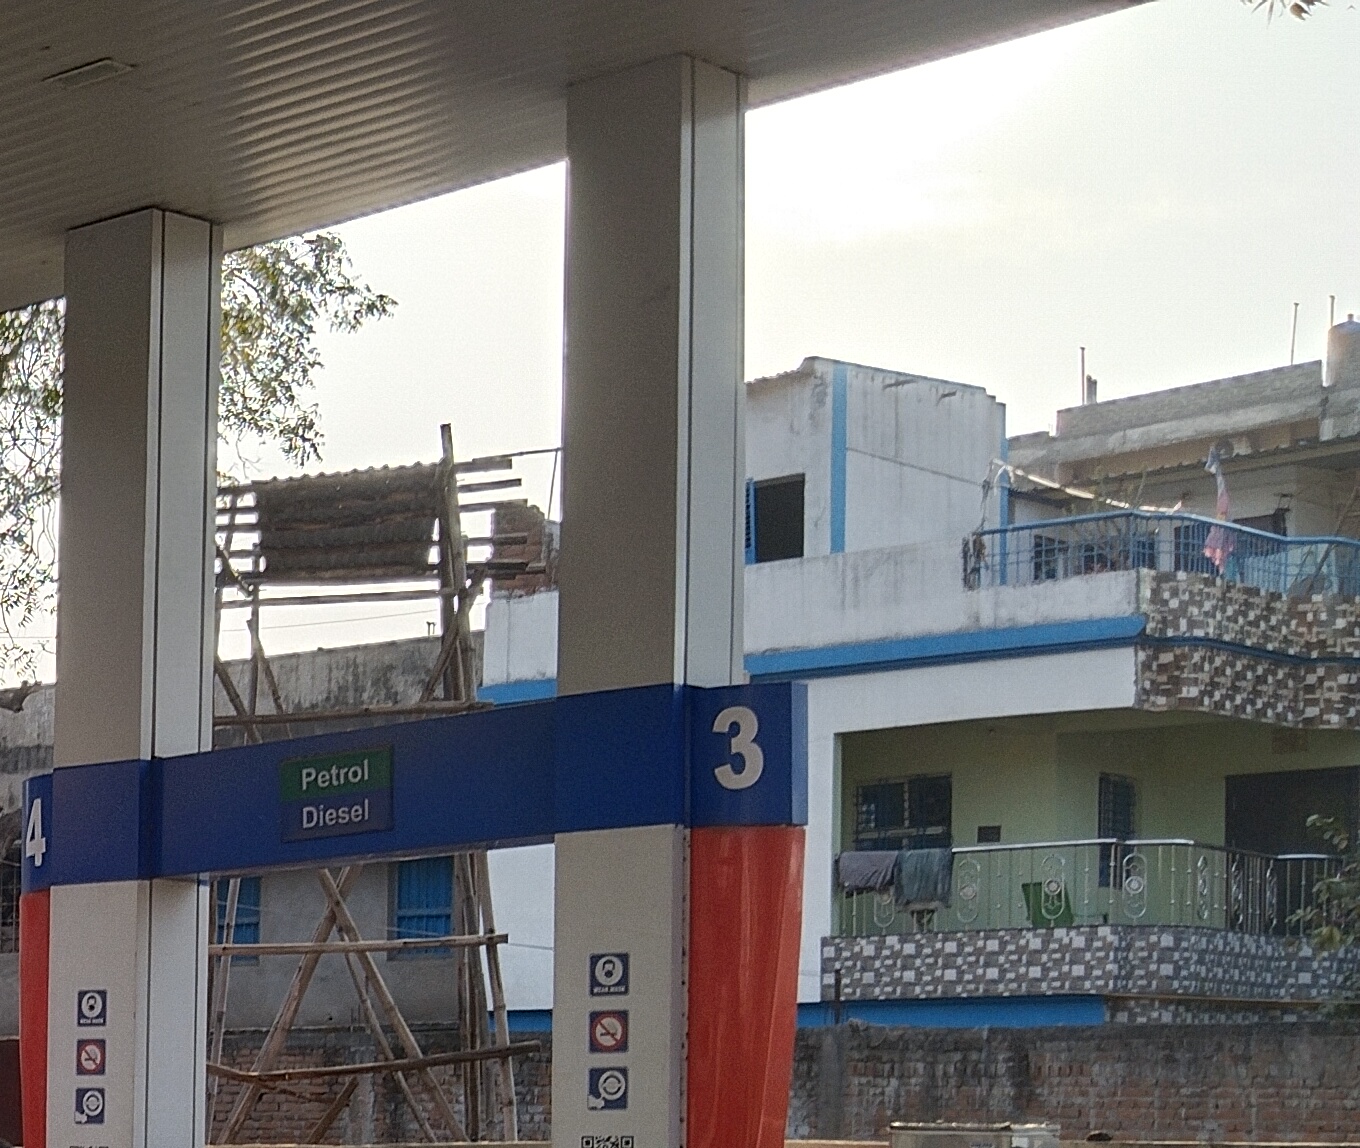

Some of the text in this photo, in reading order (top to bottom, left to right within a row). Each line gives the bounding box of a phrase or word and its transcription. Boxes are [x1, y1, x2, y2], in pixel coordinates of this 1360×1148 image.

[712, 705, 764, 790] 3
[301, 758, 369, 791] Petrol
[25, 797, 46, 868] 4
[302, 798, 369, 829] Diesel
